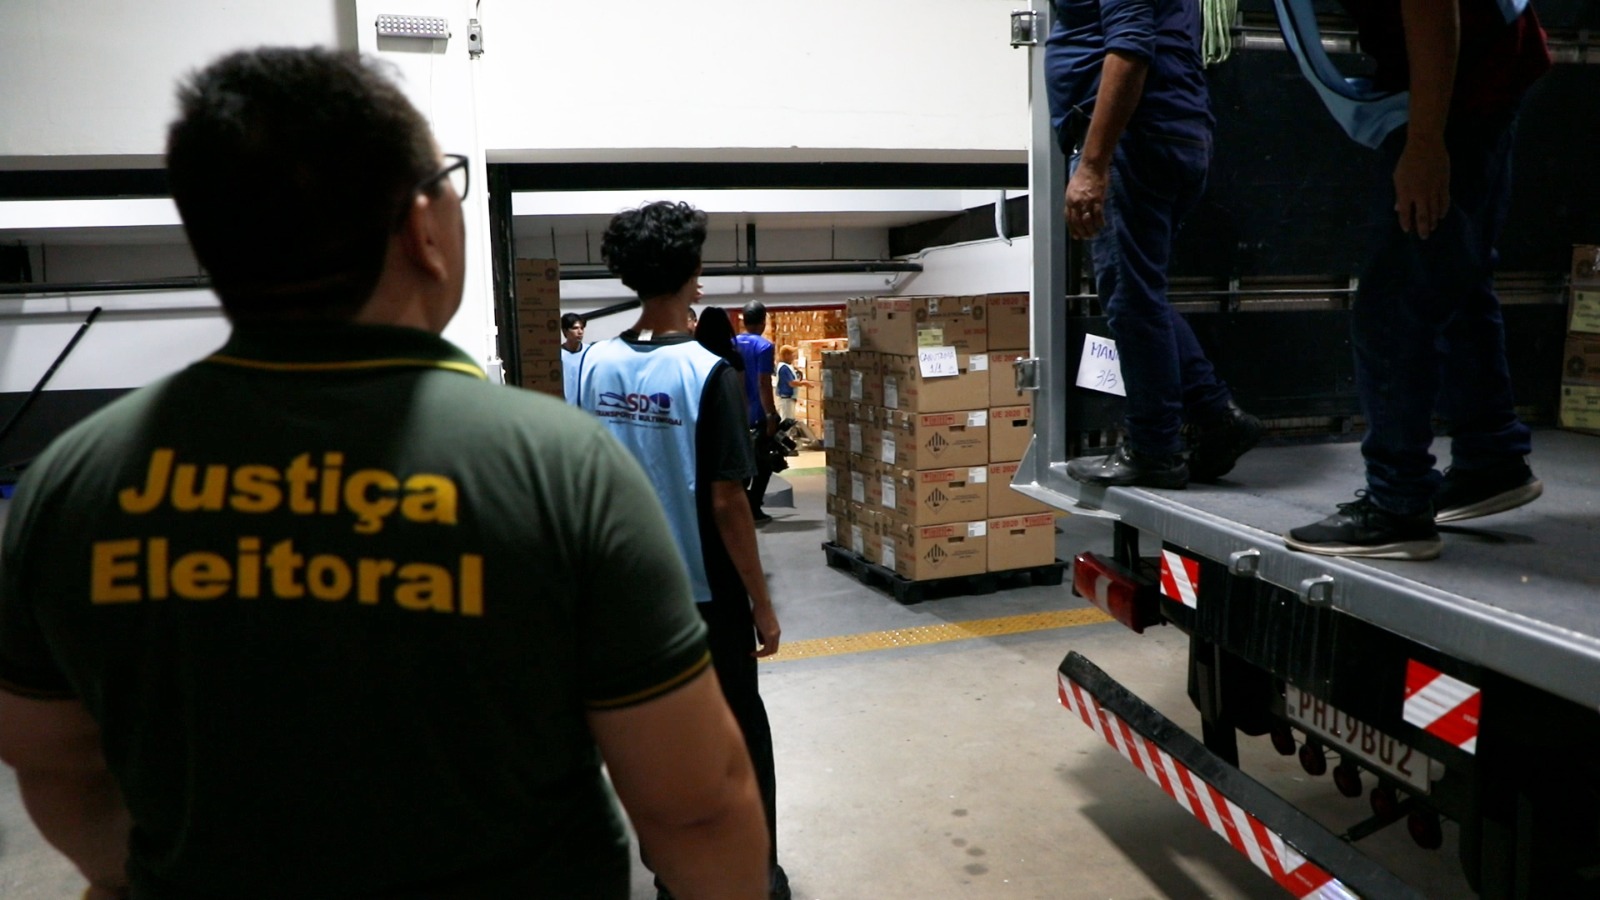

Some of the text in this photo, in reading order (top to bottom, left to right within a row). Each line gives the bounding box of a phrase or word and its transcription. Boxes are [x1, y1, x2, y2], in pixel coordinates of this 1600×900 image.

[991, 354, 1002, 362] UE
[1090, 342, 1119, 361] MAN
[1095, 369, 1118, 389] 3/3
[626, 393, 650, 413] SD
[1004, 409, 1021, 417] 2020
[990, 466, 1001, 474] UE
[118, 448, 458, 533] Justiça
[990, 521, 1001, 529] UE
[91, 537, 483, 616] Eleitoral
